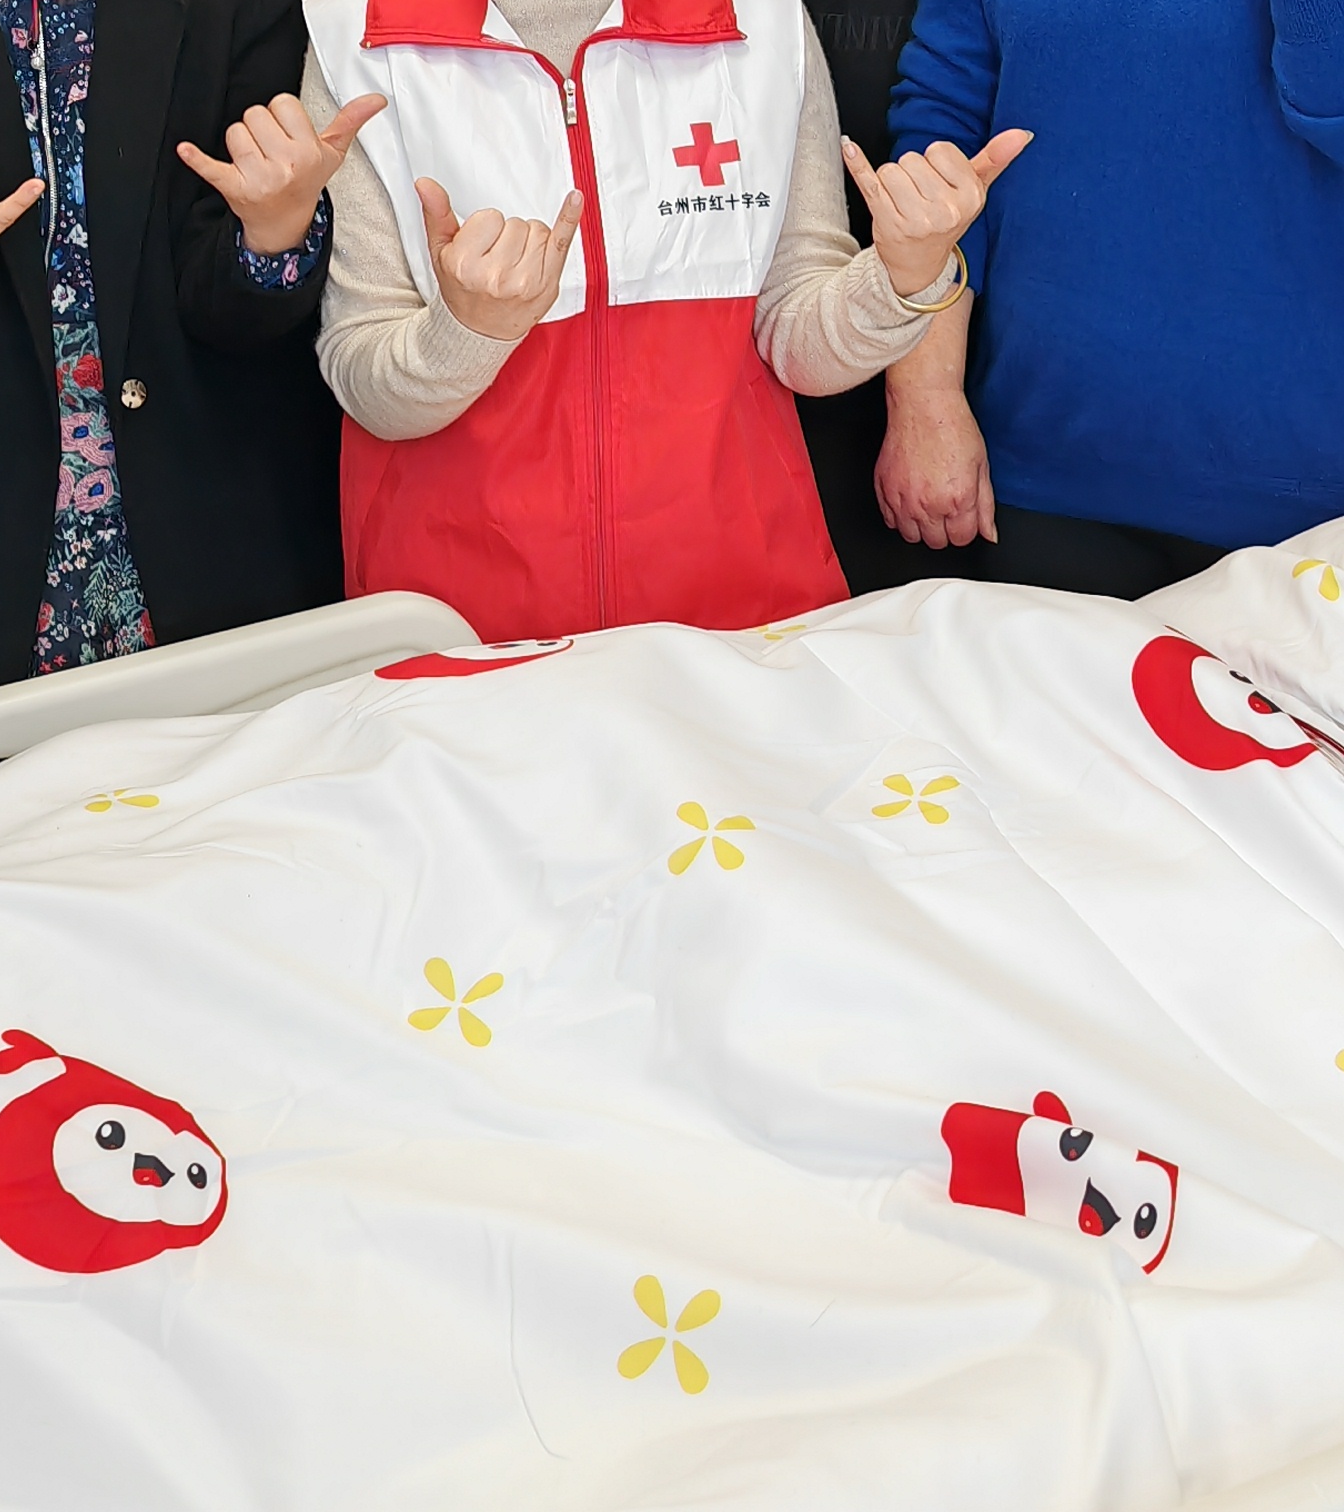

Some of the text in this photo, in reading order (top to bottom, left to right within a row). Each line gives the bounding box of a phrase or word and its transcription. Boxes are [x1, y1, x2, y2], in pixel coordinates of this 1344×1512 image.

[657, 191, 772, 217] 台州市红十字会
